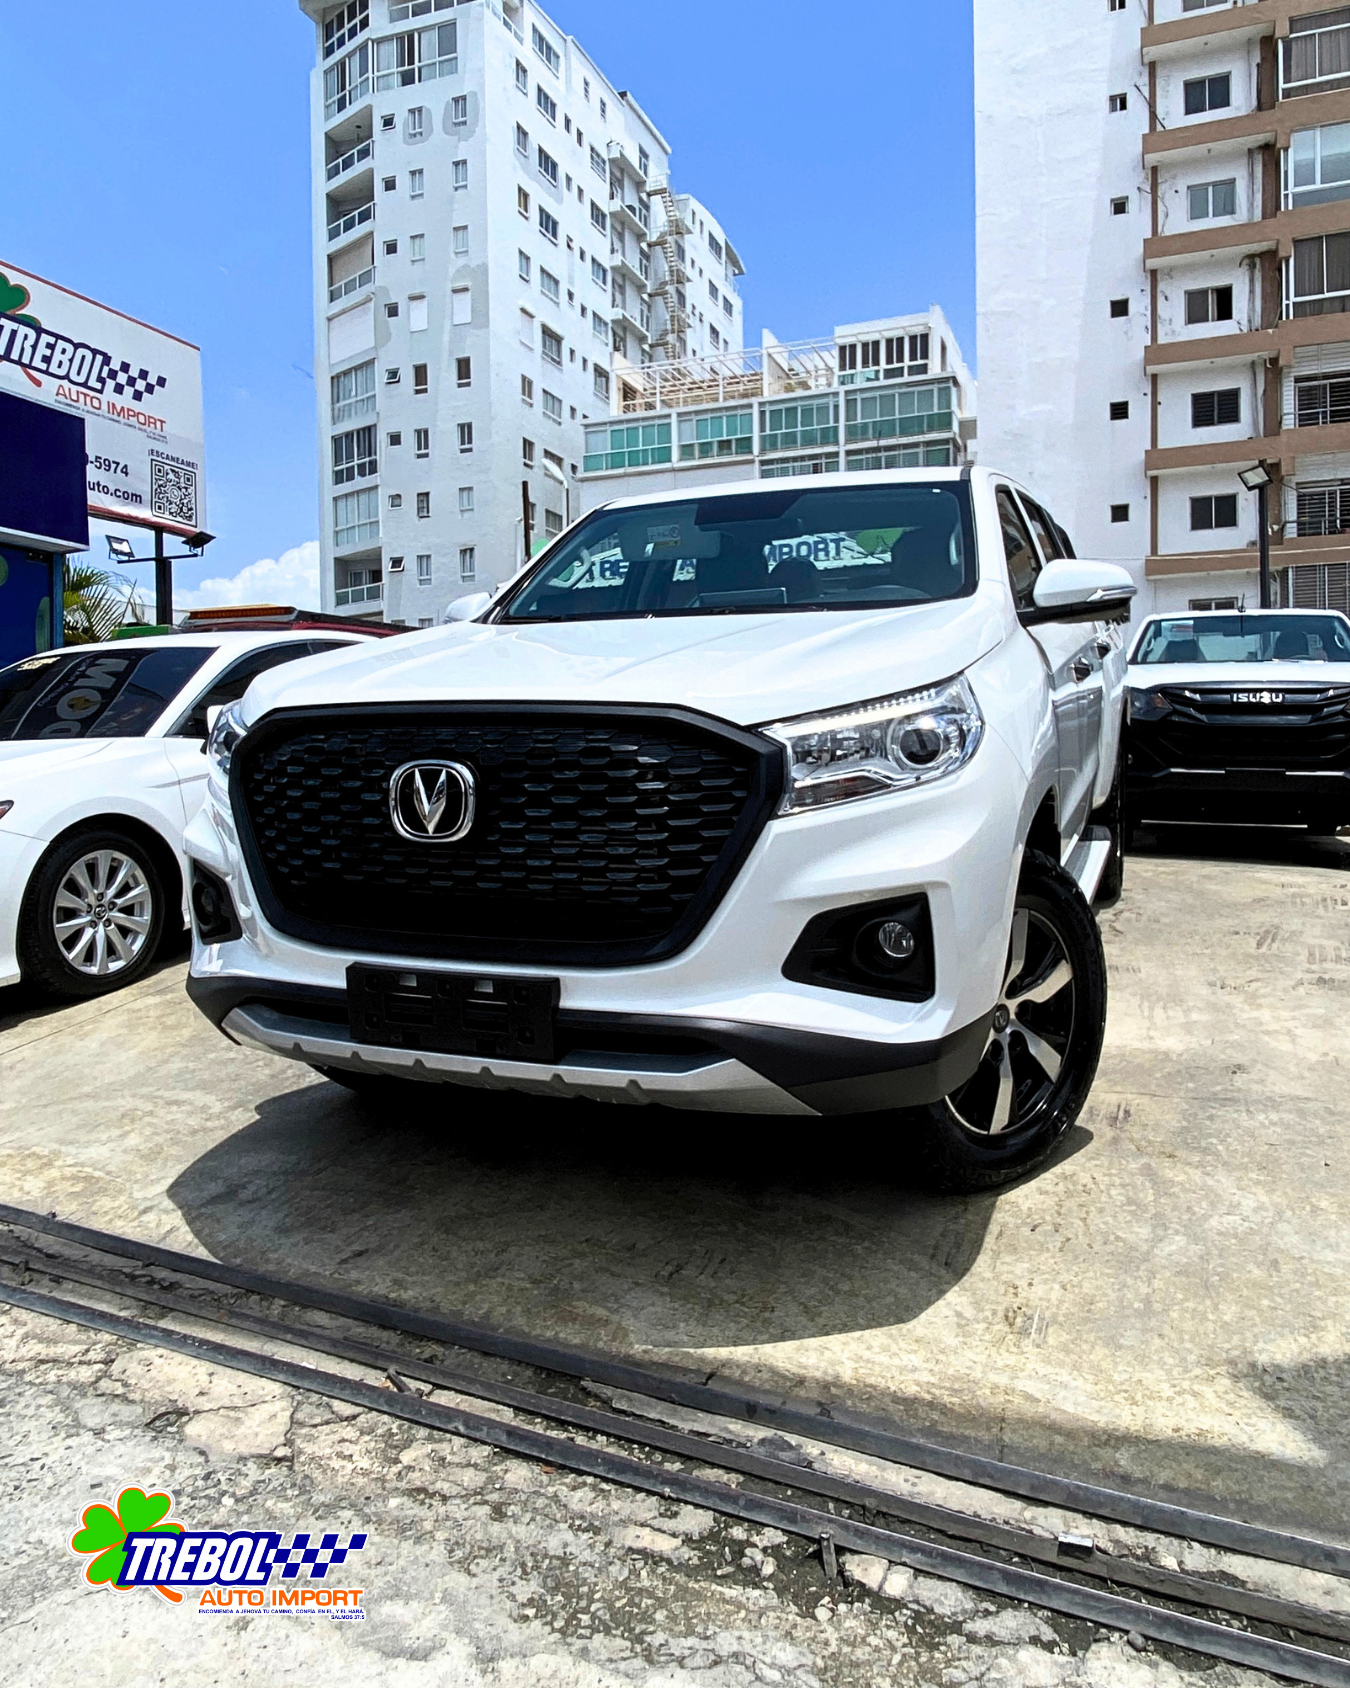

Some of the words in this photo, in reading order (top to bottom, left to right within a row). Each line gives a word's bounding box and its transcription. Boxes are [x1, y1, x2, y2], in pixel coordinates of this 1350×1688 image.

[0, 317, 104, 390] TREBOL
[55, 384, 102, 411] AUTO
[107, 400, 167, 433] IMPORT
[1232, 691, 1284, 704] ISUZU
